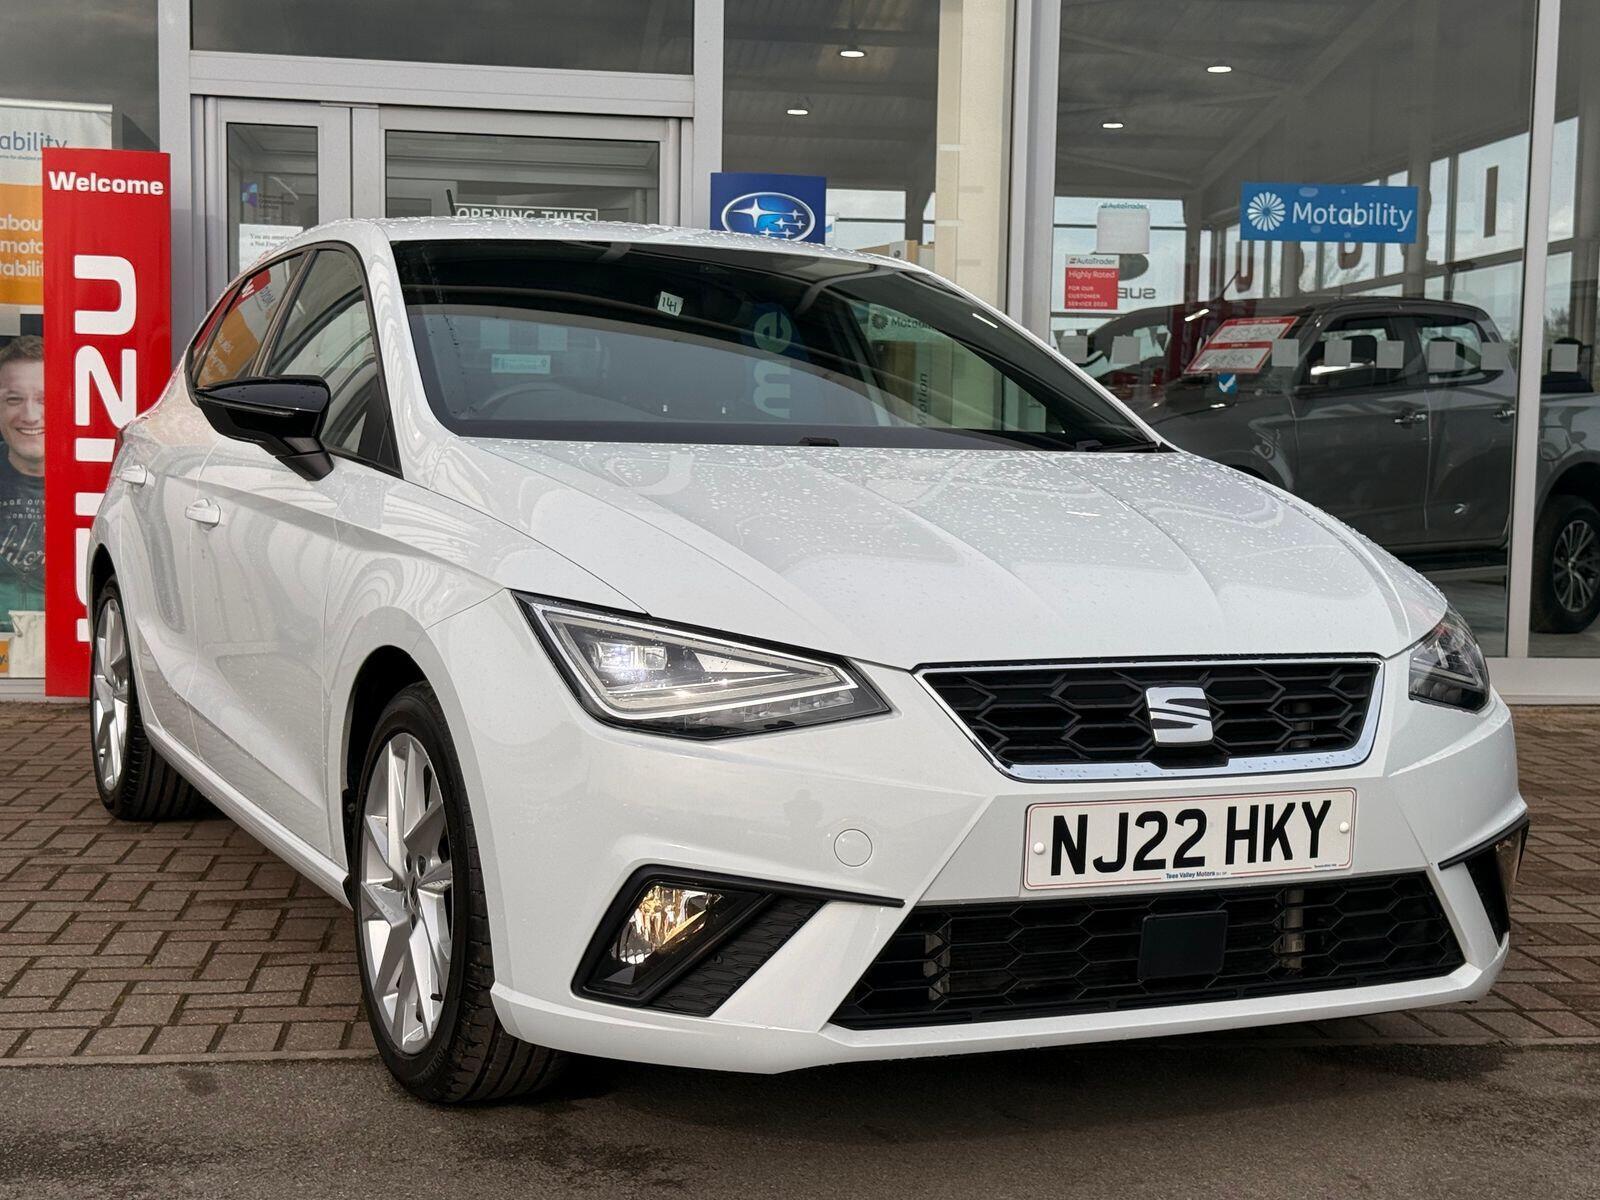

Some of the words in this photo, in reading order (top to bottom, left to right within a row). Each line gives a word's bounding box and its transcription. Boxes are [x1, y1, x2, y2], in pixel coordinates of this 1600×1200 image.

[48, 171, 164, 196] Welcome
[1292, 202, 1413, 233] Motability
[1076, 257, 1116, 266] AutoTrader
[1068, 271, 1092, 281] Highly
[1092, 271, 1116, 279] Rated
[1051, 808, 1207, 876] NJ22
[1225, 800, 1332, 866] HKY
